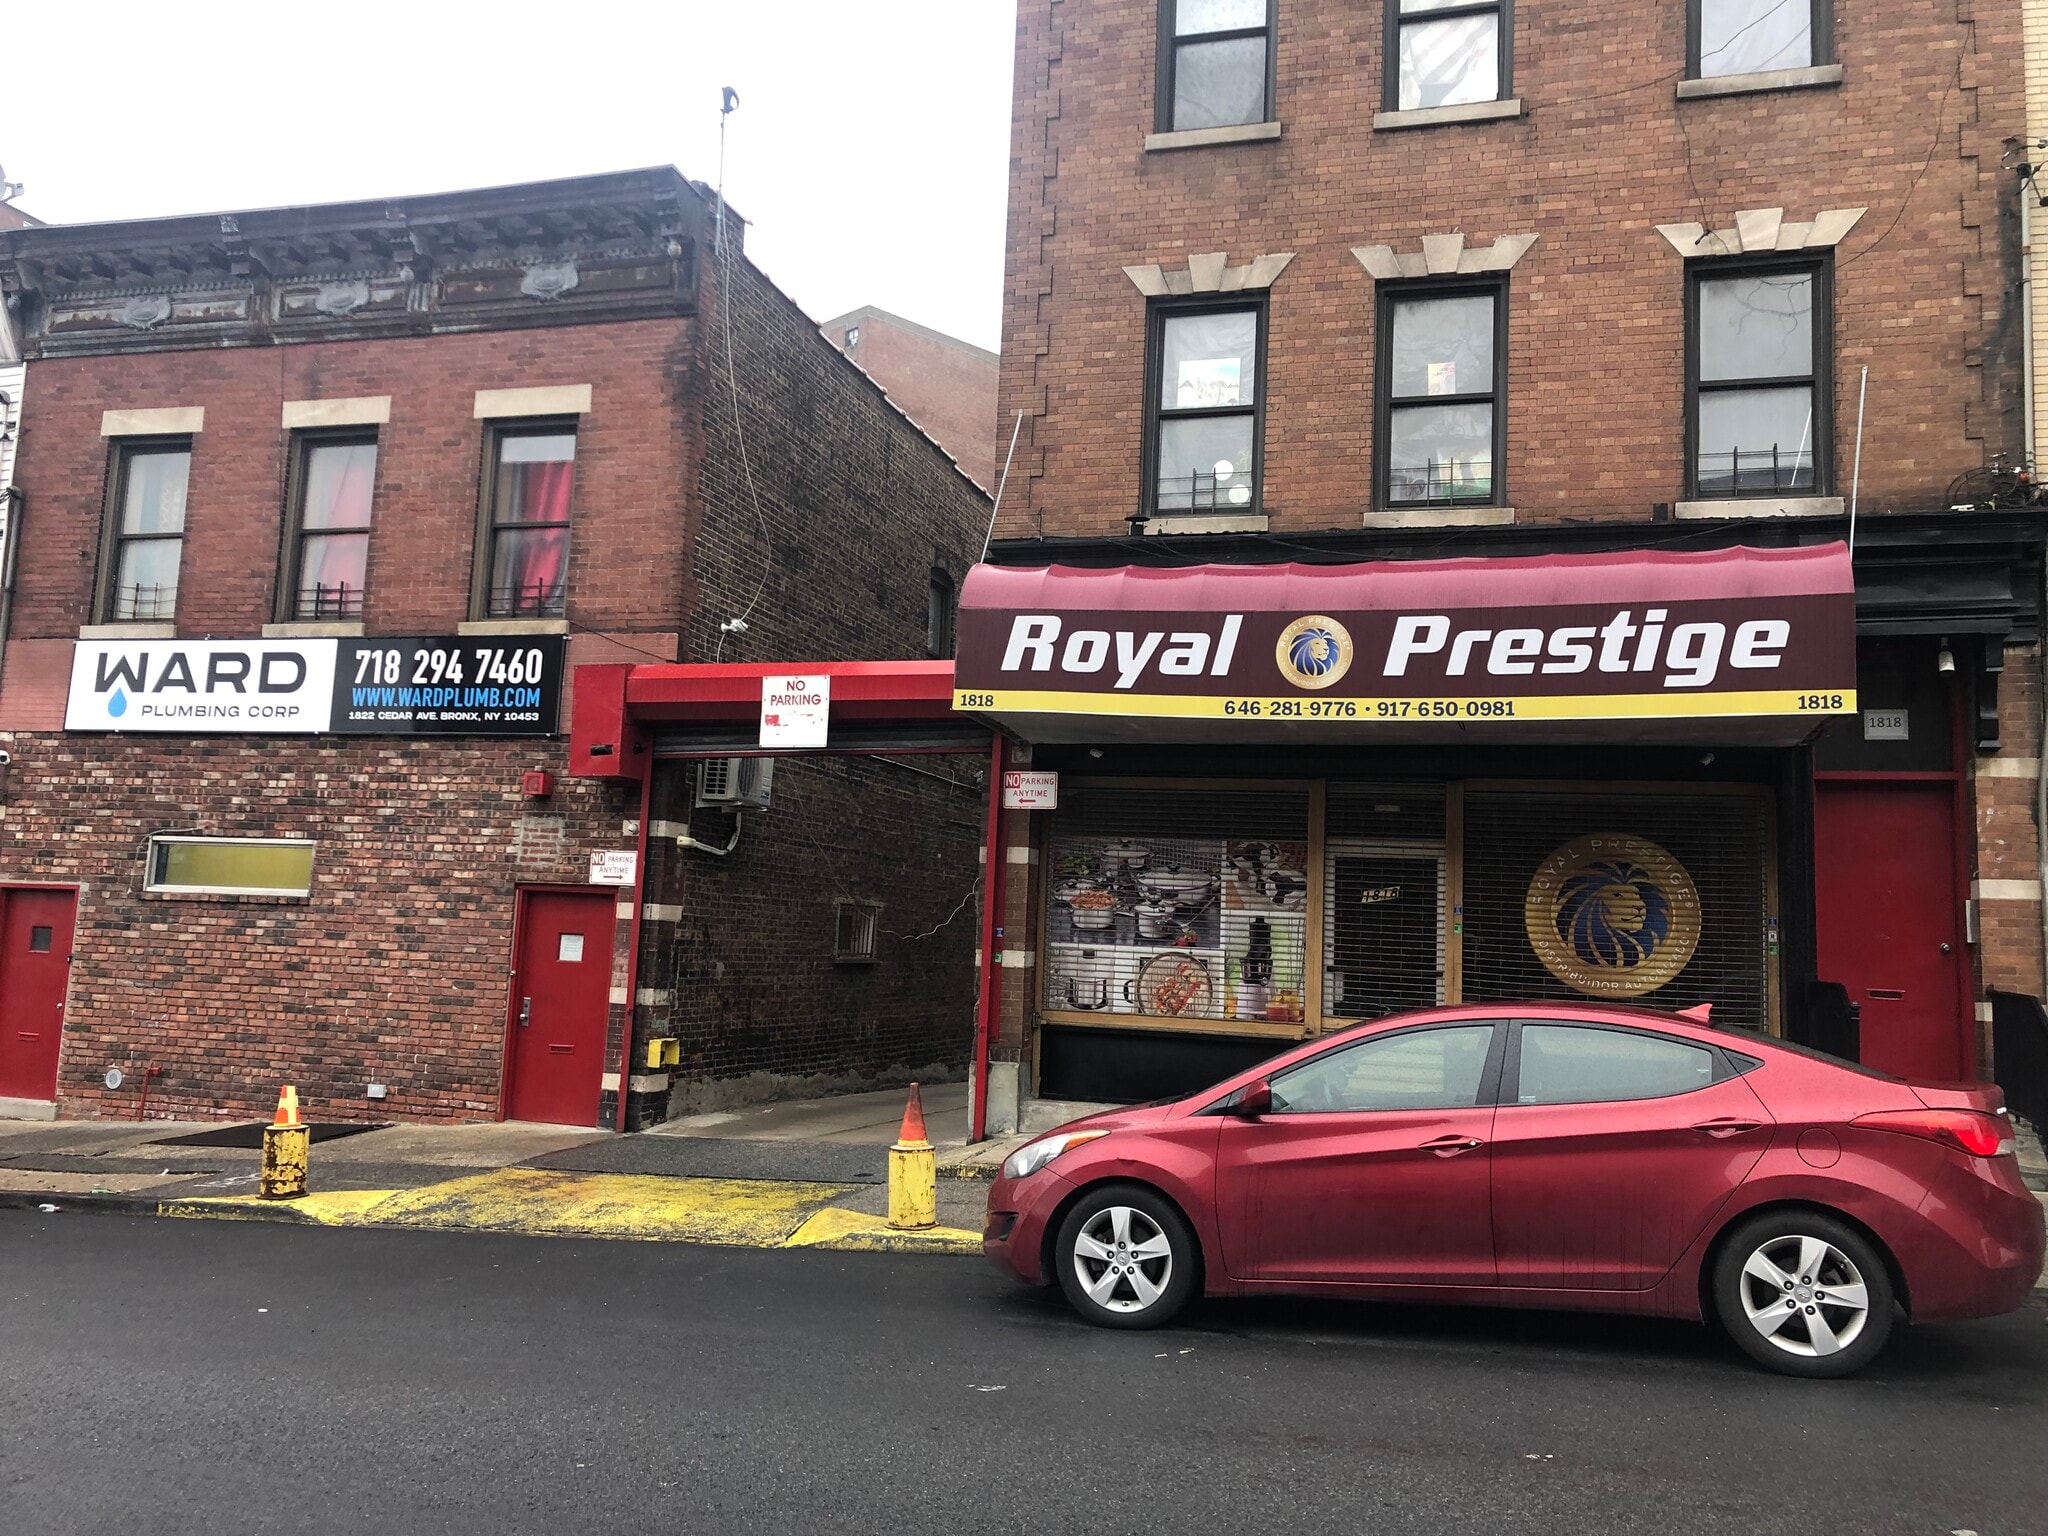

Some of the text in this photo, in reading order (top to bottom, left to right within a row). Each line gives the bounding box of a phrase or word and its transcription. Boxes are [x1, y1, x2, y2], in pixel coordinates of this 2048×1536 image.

[1280, 622, 1304, 648] ROYAL
[1000, 609, 1790, 688] Royal Prestige
[94, 652, 307, 693] WARD
[354, 648, 543, 684] 718 294 7460
[786, 680, 806, 691] NO
[352, 687, 541, 707] WWW.WARDPLUMB.COM
[770, 694, 822, 706] PARKING
[960, 694, 994, 707] 1818
[1797, 694, 1843, 709] 1818
[141, 705, 300, 718] PLUMBING CORP
[1224, 700, 1515, 717] 646-281-9776 917-650-0981
[348, 711, 539, 722] 1822 CEDAR AVE. BRONX, NY 10453
[1869, 717, 1902, 728] 1818
[1006, 774, 1055, 787] NO PARKING
[592, 853, 634, 864] NO PARKING
[1365, 887, 1398, 902] 1818
